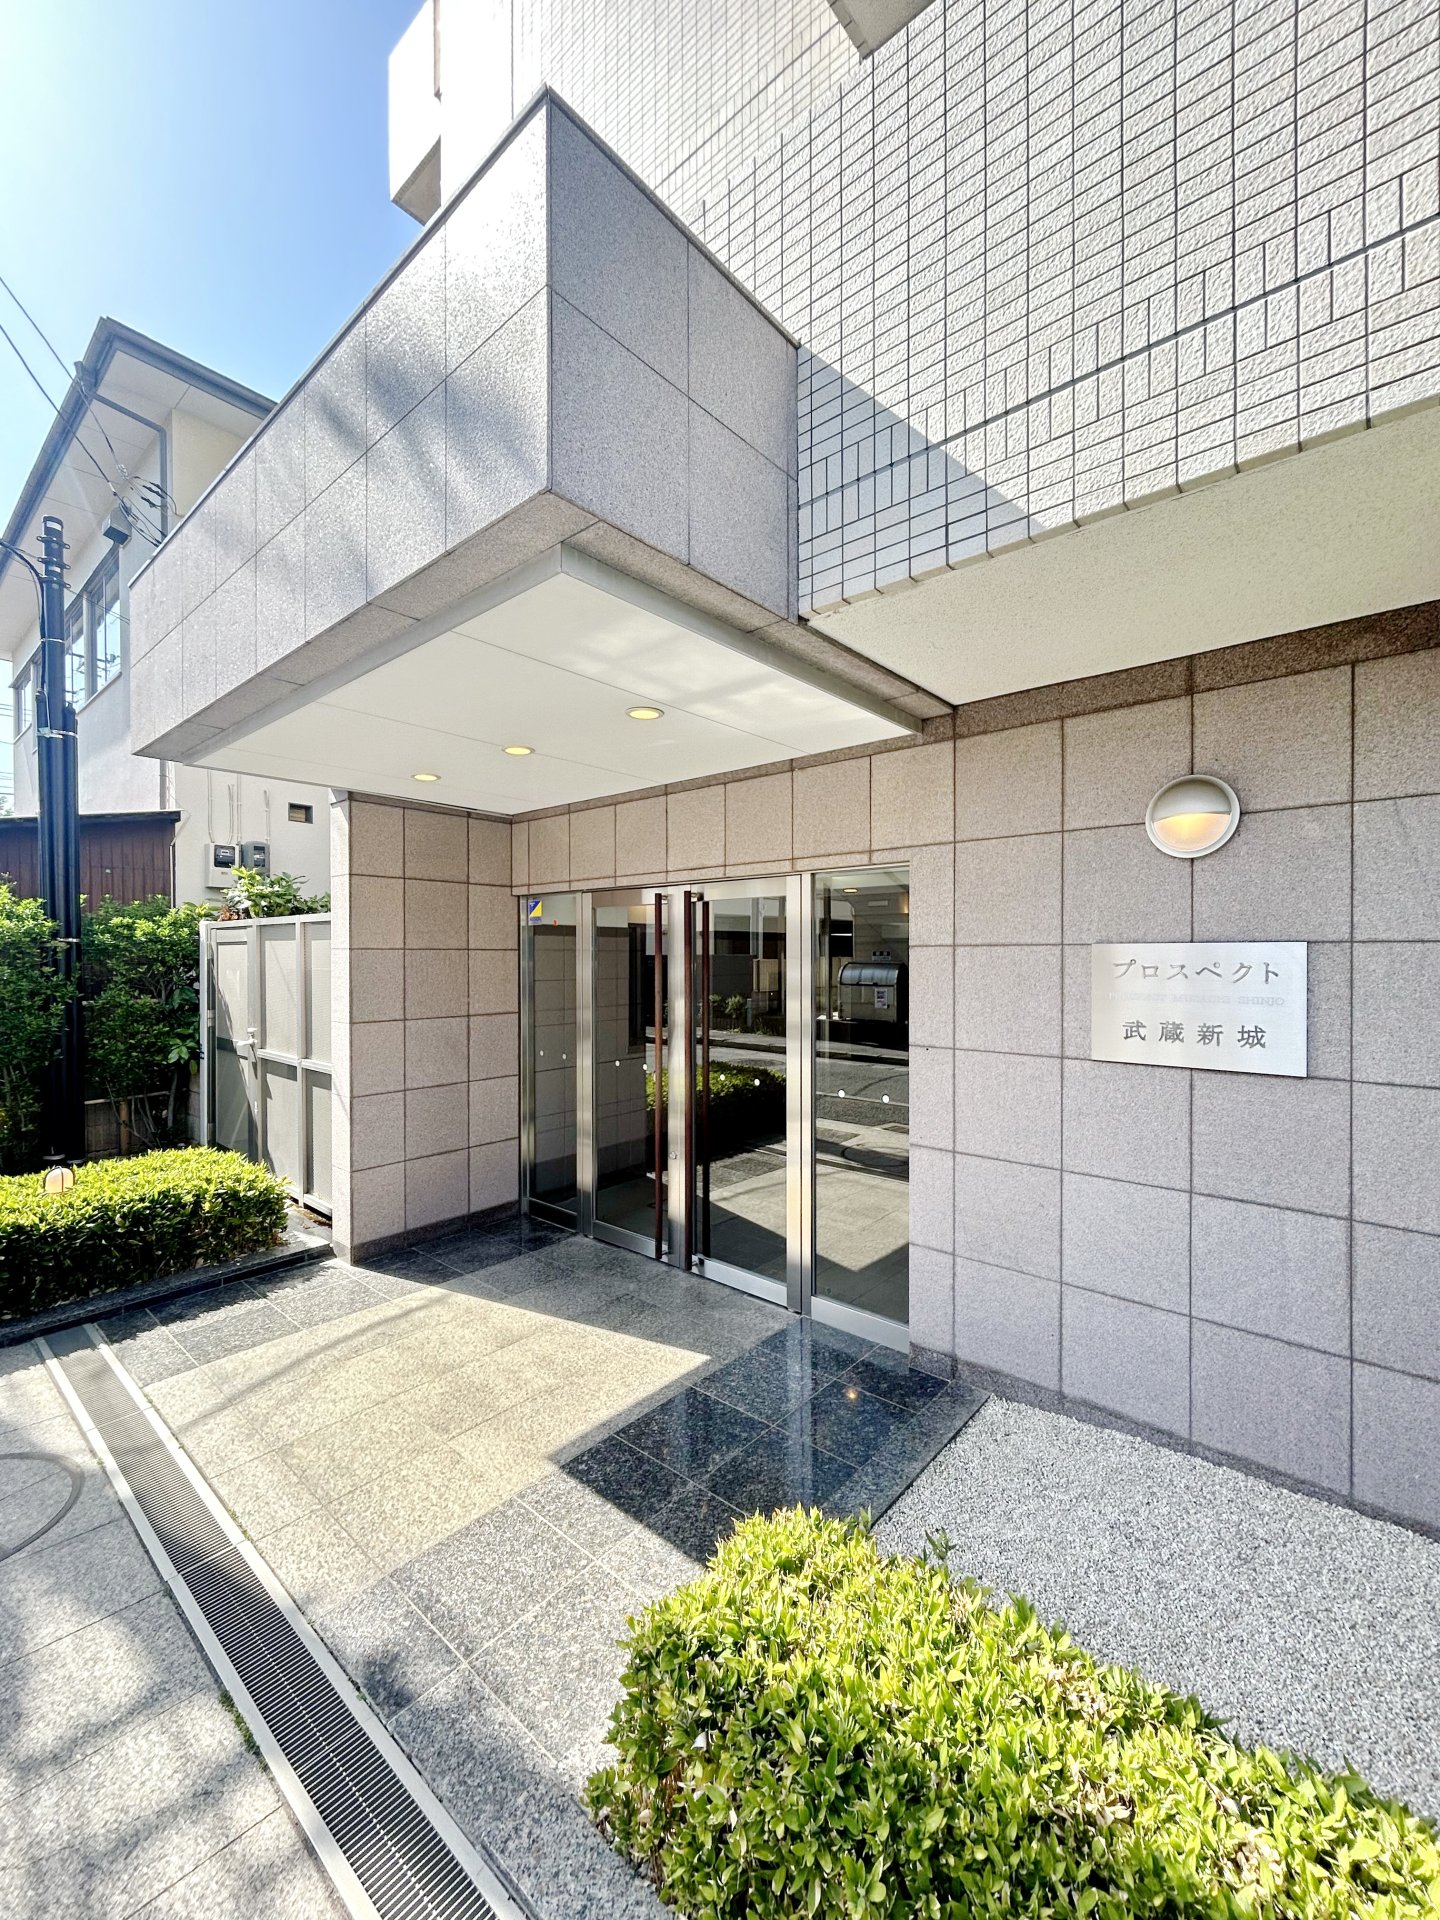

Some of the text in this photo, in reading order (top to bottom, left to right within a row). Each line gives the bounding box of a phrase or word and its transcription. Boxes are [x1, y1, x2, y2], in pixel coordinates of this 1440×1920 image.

[1113, 959, 1279, 984] プロスペクト
[1122, 1020, 1266, 1048] 武蔵新城
